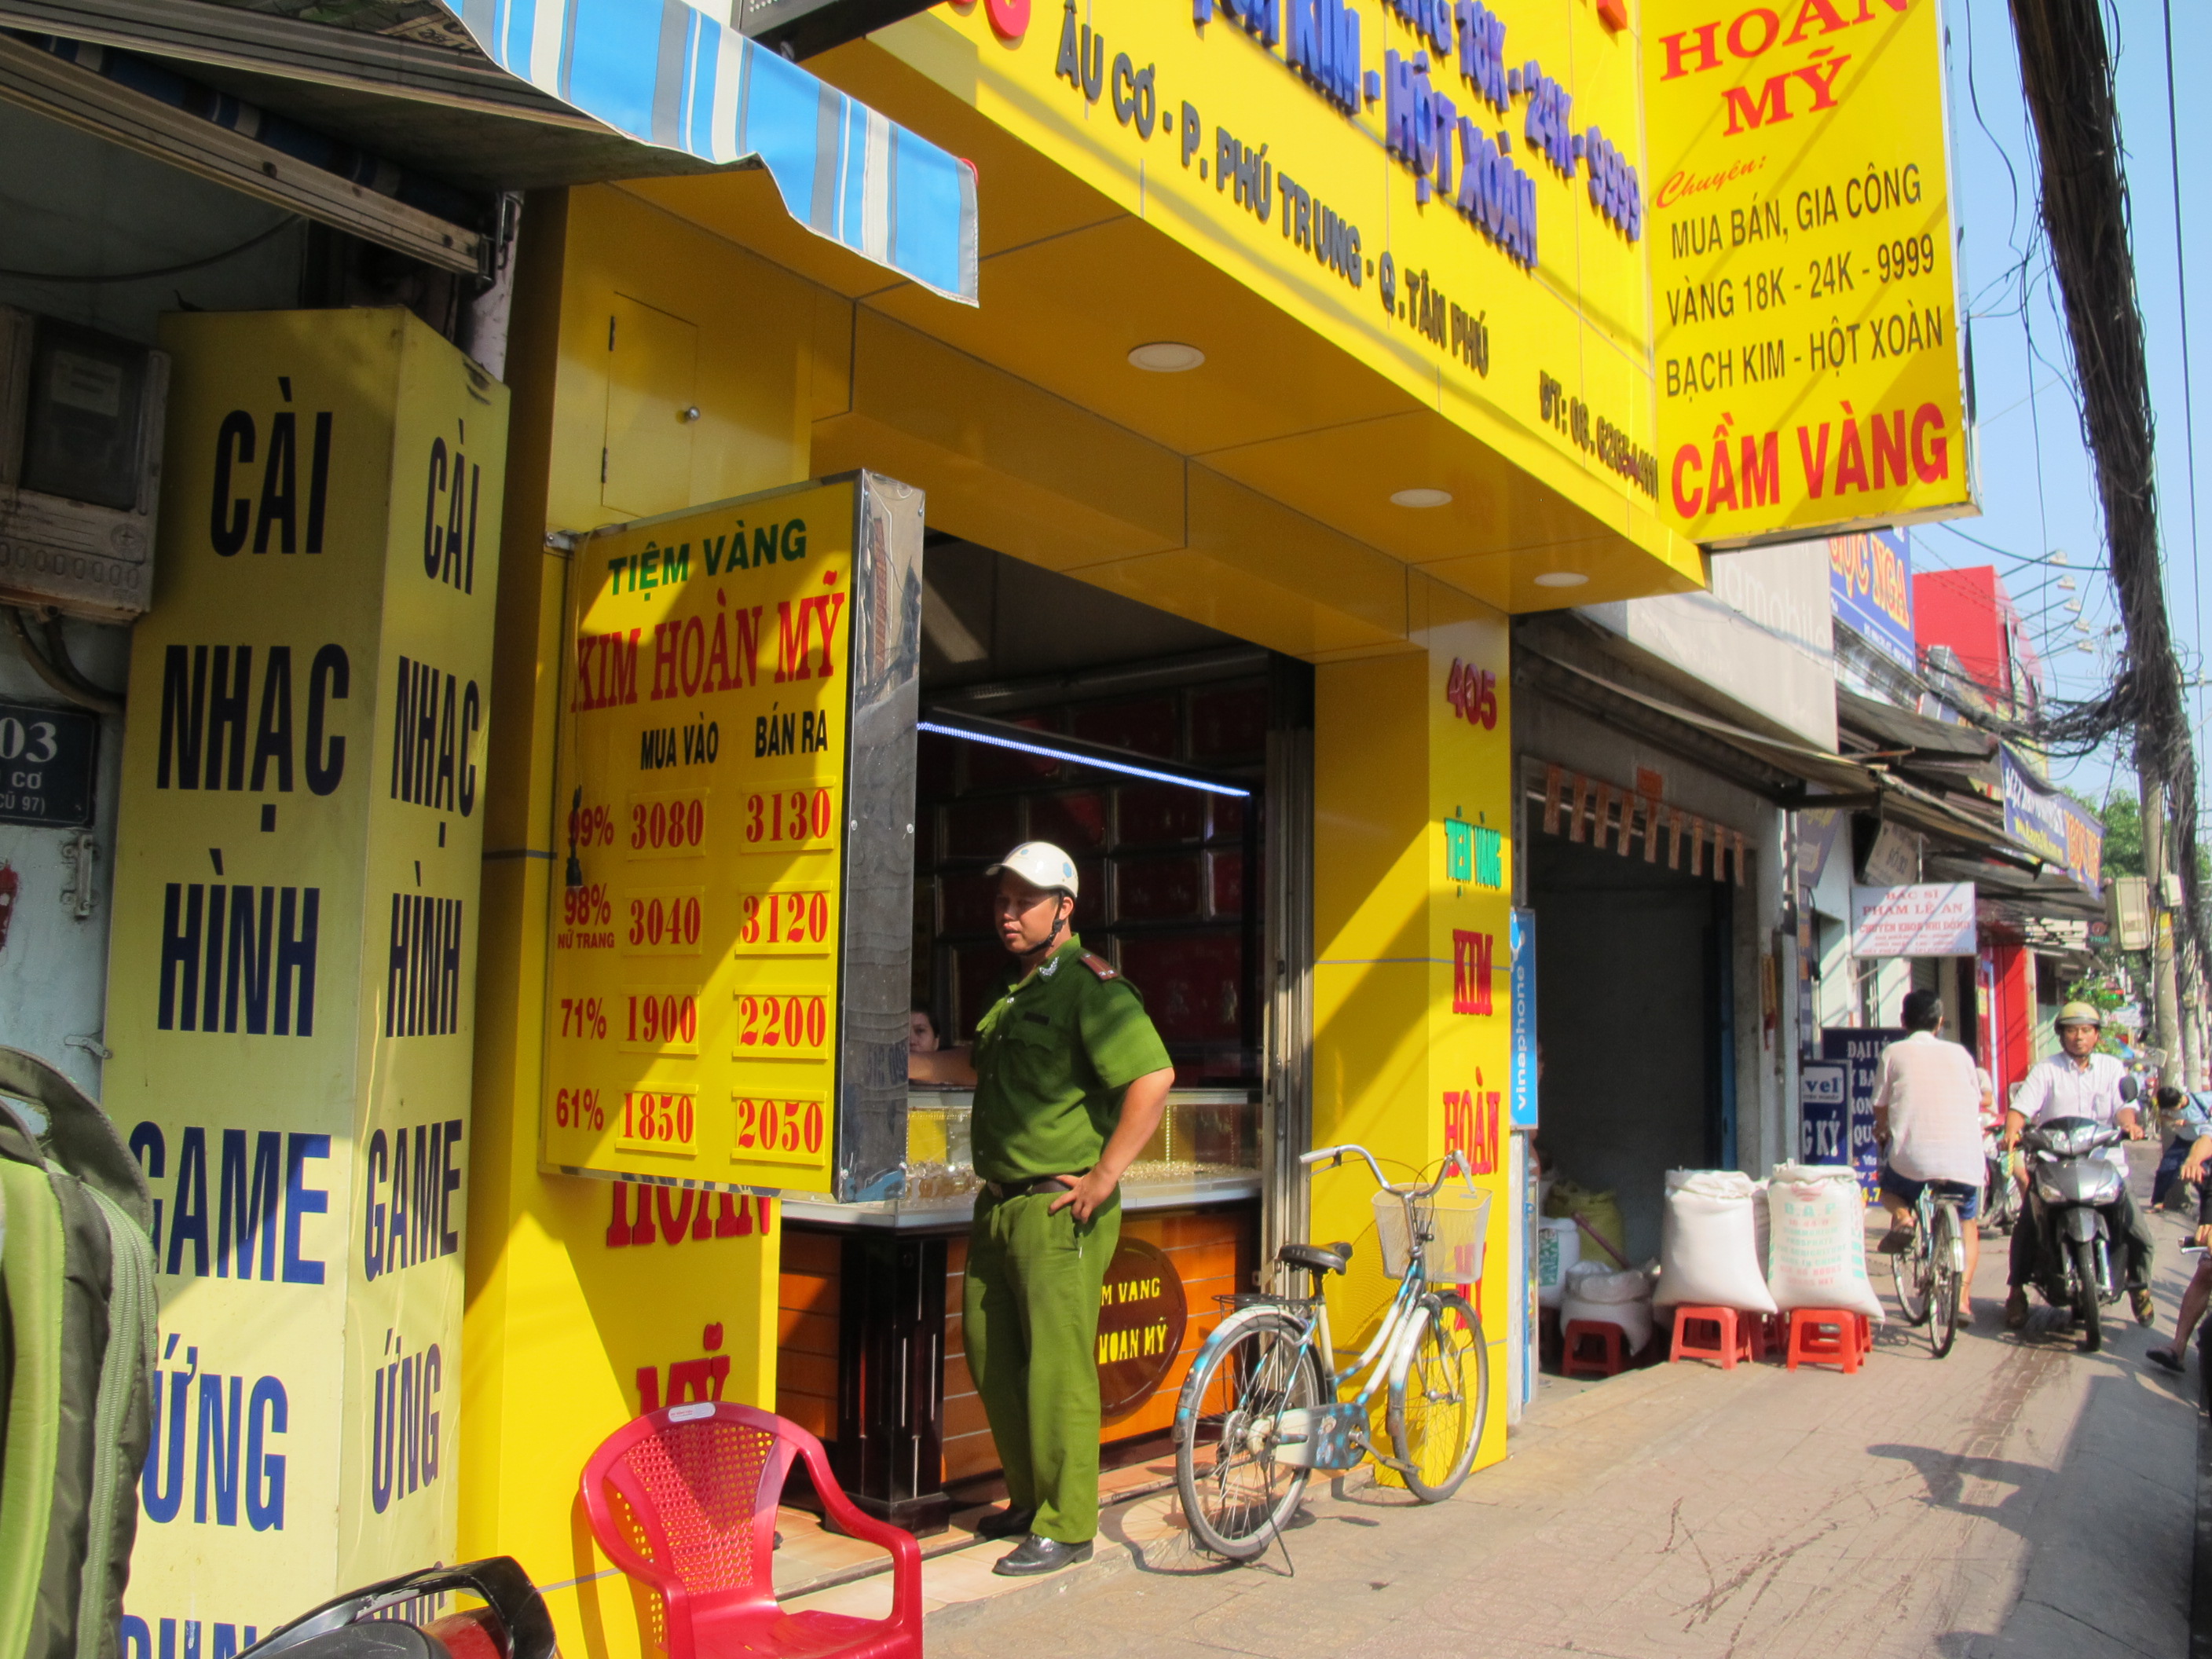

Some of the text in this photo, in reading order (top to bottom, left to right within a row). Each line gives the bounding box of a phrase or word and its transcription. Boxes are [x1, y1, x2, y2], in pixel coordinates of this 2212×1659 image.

[1721, 45, 1852, 137] MỸ
[1111, 52, 1155, 140] CƠ
[1277, 170, 1362, 288] TRUNG
[1451, 310, 1489, 379] PHÚ
[1656, 156, 1767, 210] Chuyên:
[1672, 162, 1921, 260] MUA BÁN, GIA CÔNG
[1666, 276, 1734, 327] VÀNG
[1743, 266, 1786, 313] 18K
[1809, 251, 1855, 299] 24K
[1877, 233, 1935, 284] 9999
[1666, 349, 1734, 402] BẠCH
[1742, 339, 1785, 385] KIM
[1809, 315, 1861, 377] HỘT
[1870, 299, 1943, 361] XOÀN
[210, 376, 333, 557] CÀI
[423, 418, 480, 595] CÀI
[1671, 400, 1949, 519] CẦM VÀNG
[608, 518, 808, 602] TIỆM VÀNG
[570, 570, 845, 713] KIM HOÀN MỸ
[157, 643, 350, 833] NHẠC
[640, 712, 719, 771] MUA VÀO
[754, 701, 829, 759] BÁN RA
[1447, 657, 1497, 731] 405
[391, 654, 480, 848] NHẠC
[631, 799, 704, 850] 3080
[745, 789, 831, 843] 3130
[157, 848, 320, 1038] HÌNH
[385, 860, 463, 1038] HÌNH
[564, 883, 829, 946] 98% 3040 3120
[577, 932, 615, 949] TRANG
[1941, 903, 1964, 914] AN
[561, 994, 826, 1048] 71% 1900 2200
[1452, 928, 1493, 1016] KIM
[1515, 965, 1527, 1111] vinaphone
[555, 1088, 823, 1154] 61% 1850 2050
[129, 1121, 331, 1285] GAME
[364, 1119, 463, 1282] GAME
[141, 1333, 288, 1532] ỨNG
[372, 1328, 442, 1514] ỨNG
